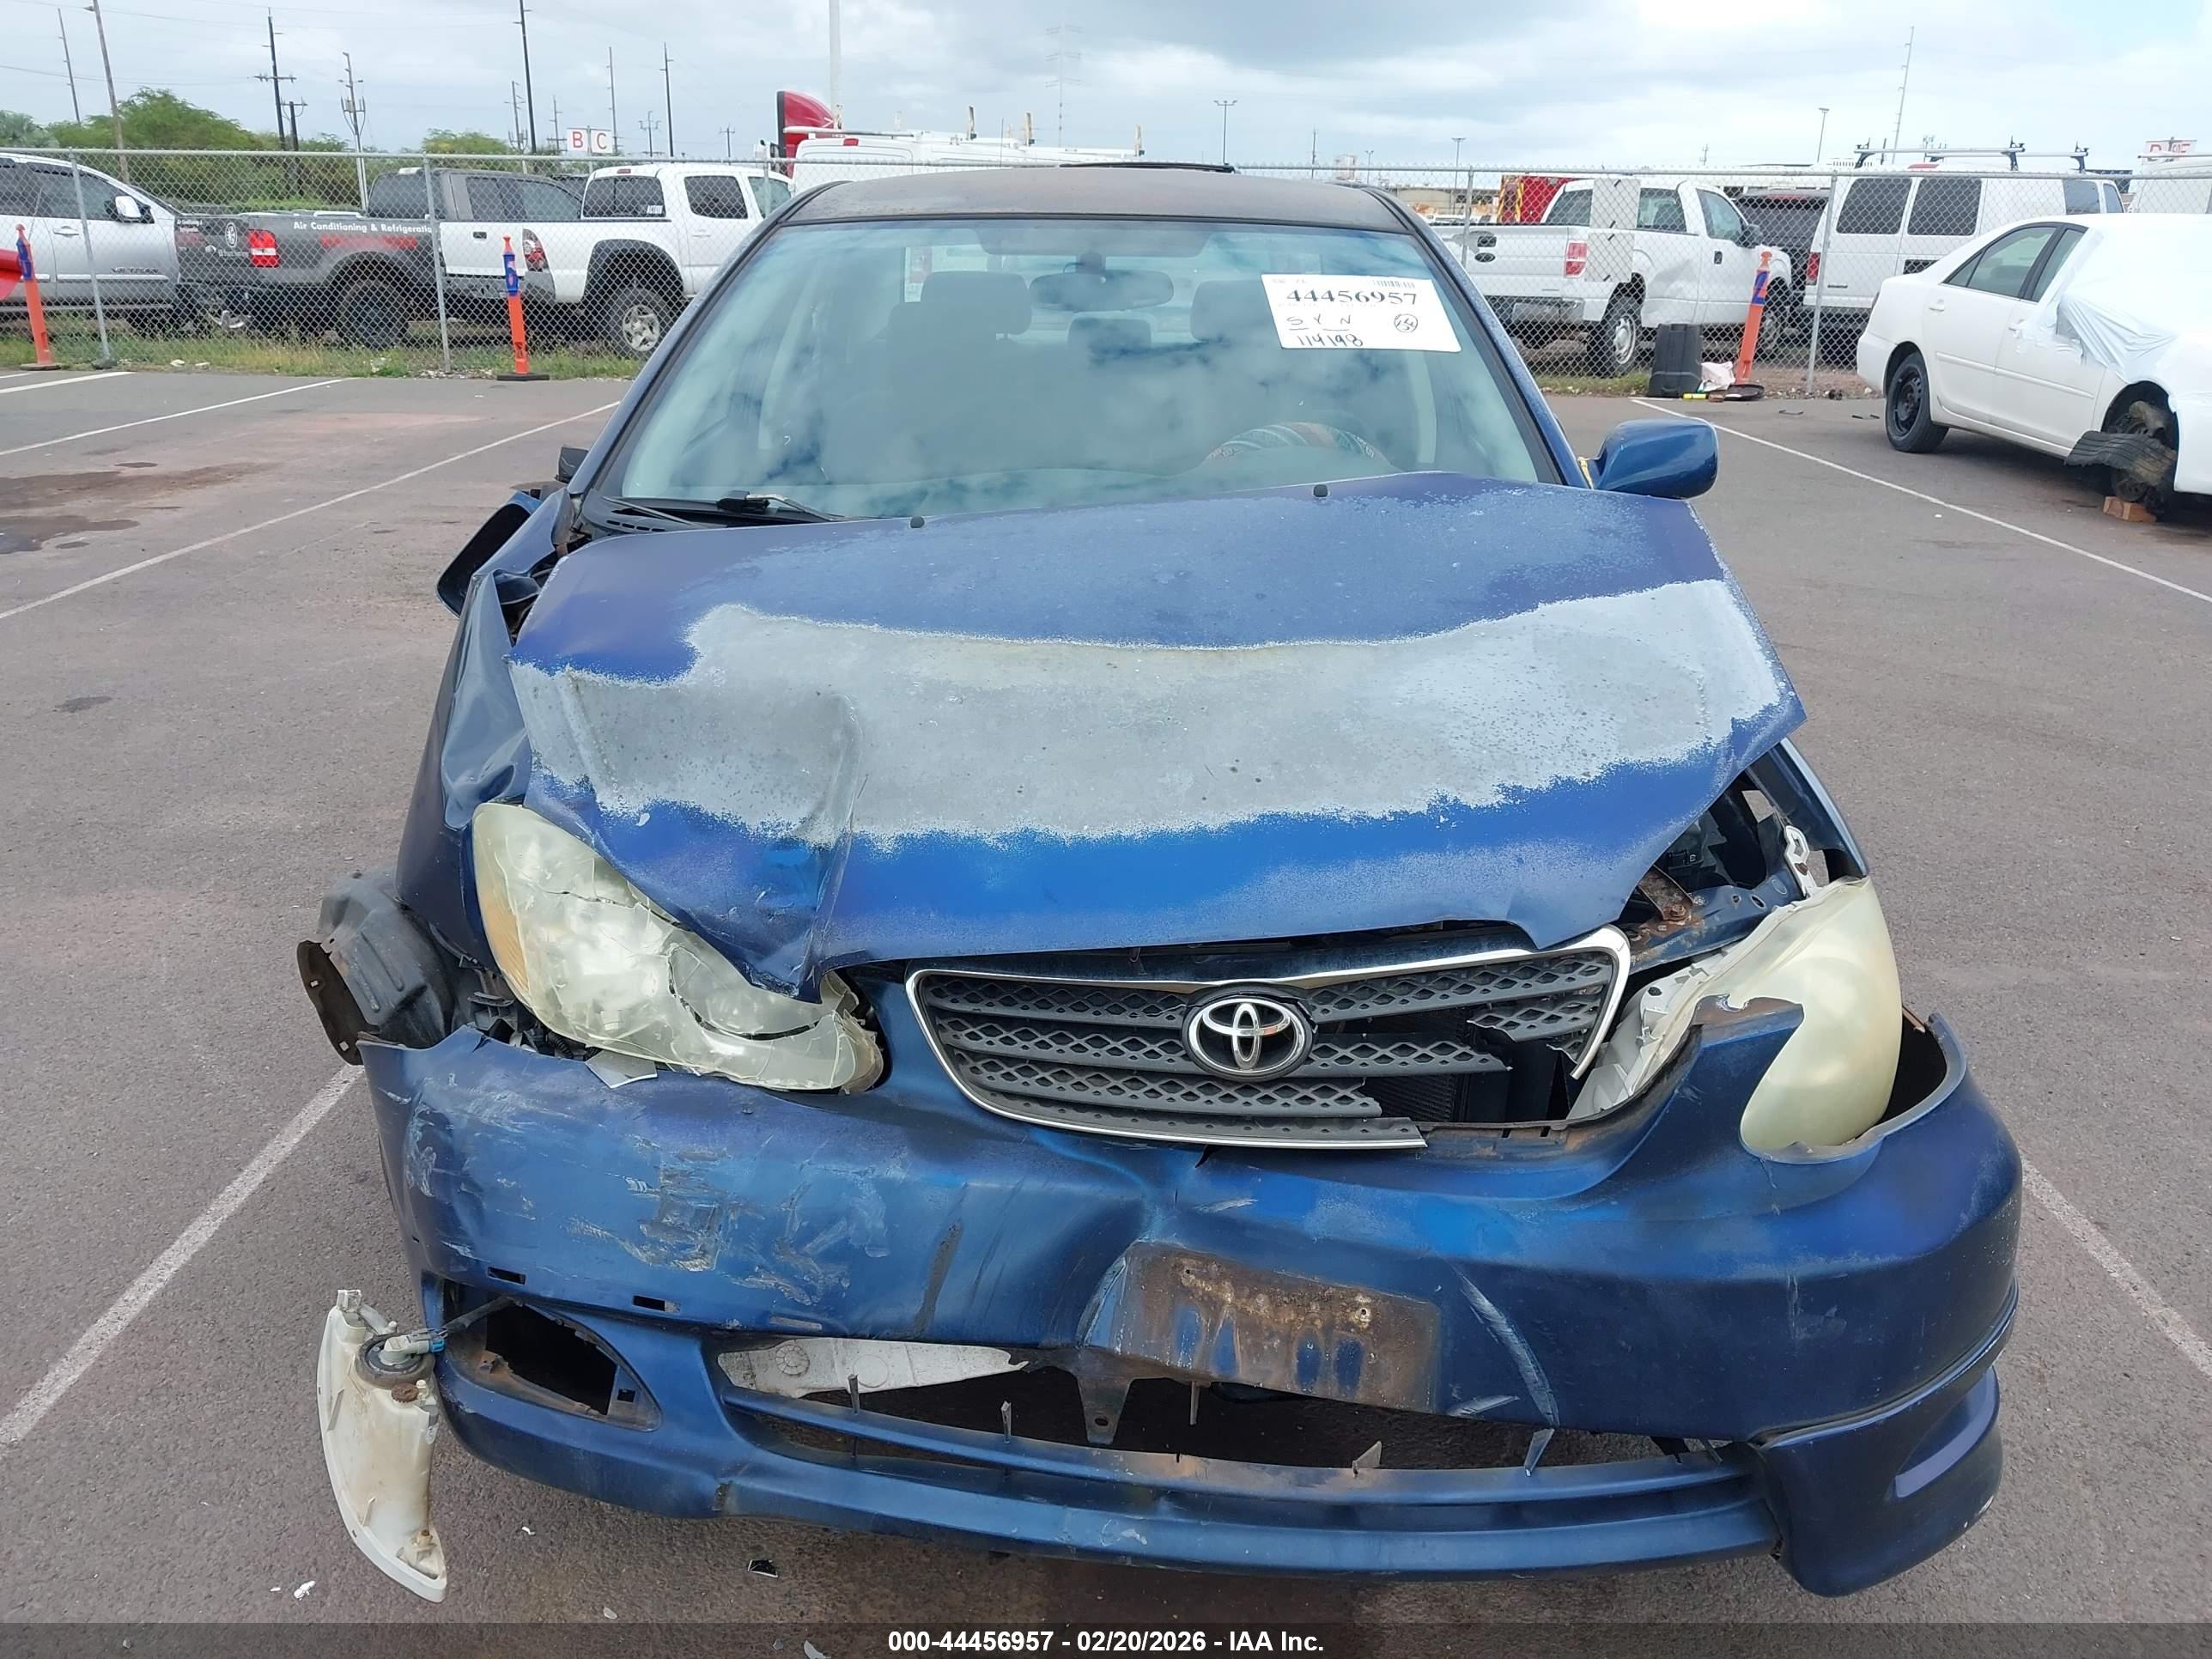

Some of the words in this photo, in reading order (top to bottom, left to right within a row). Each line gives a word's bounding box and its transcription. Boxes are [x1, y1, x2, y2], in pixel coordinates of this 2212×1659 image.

[572, 131, 584, 148] B
[596, 132, 607, 149] C
[294, 222, 307, 230] Air
[310, 222, 368, 234] Conditioning
[370, 223, 379, 232] &
[381, 223, 433, 234] Refrigeratio
[1286, 288, 1418, 305] 44456957
[1297, 333, 1364, 347] 114198
